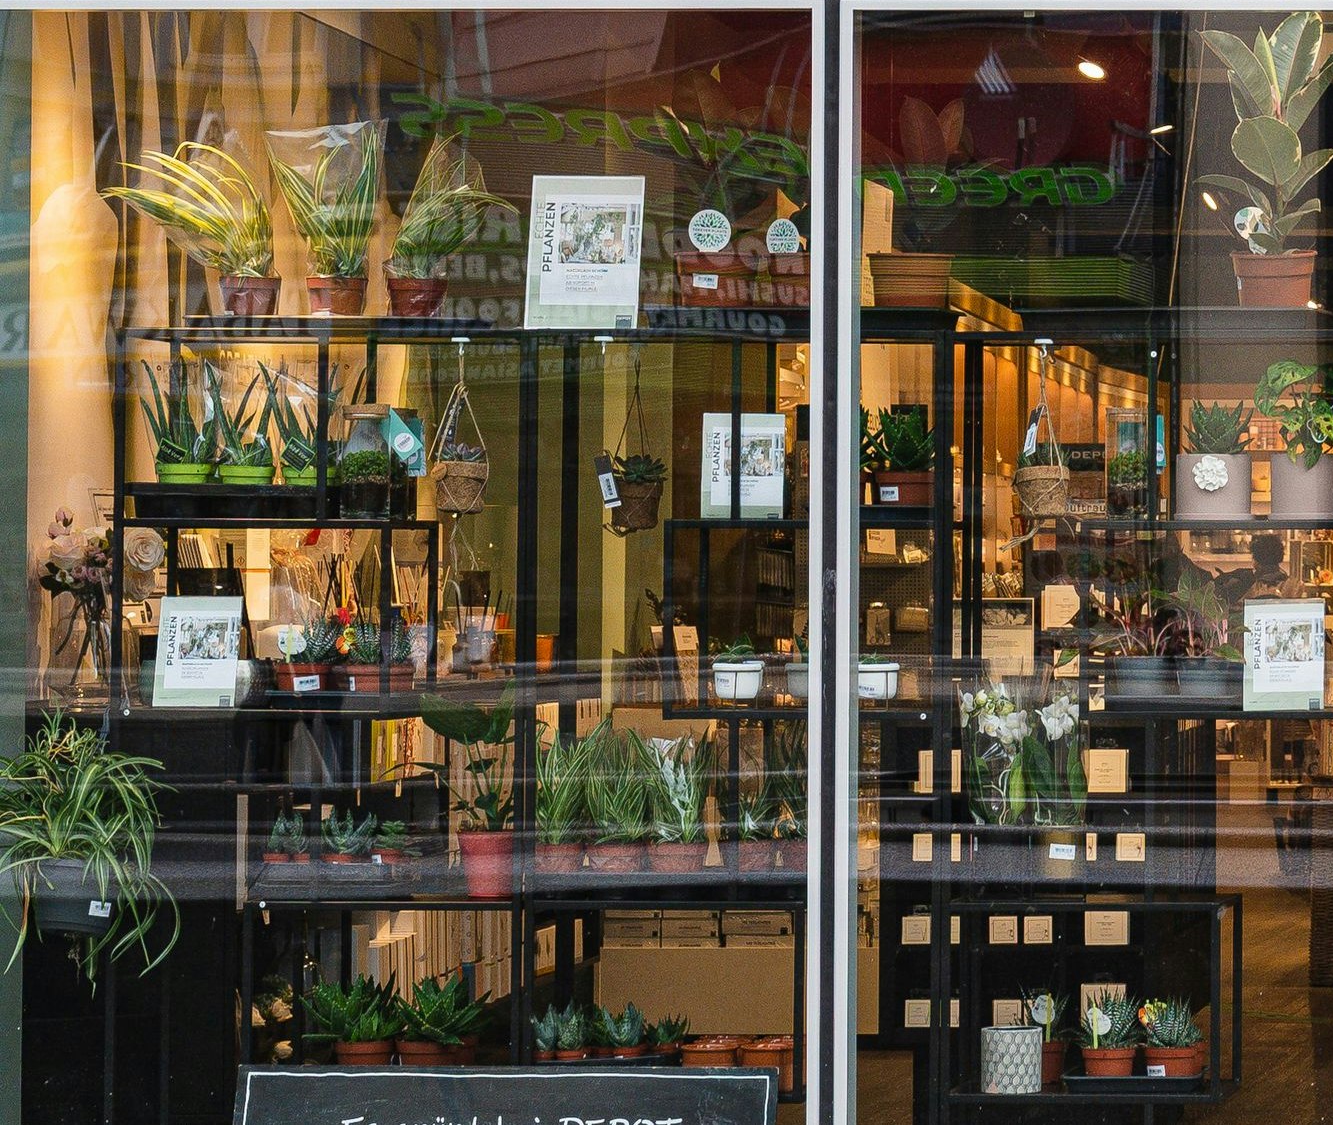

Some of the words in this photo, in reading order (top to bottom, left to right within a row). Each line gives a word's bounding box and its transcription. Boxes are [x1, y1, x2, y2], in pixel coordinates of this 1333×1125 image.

[535, 202, 545, 240] ECHTE
[543, 202, 556, 273] PFLANZEN
[712, 431, 722, 483] PFLANZEN
[1071, 451, 1107, 460] DEP
[166, 616, 178, 666] PFLANZEN
[1253, 618, 1262, 670] PFLANZEN
